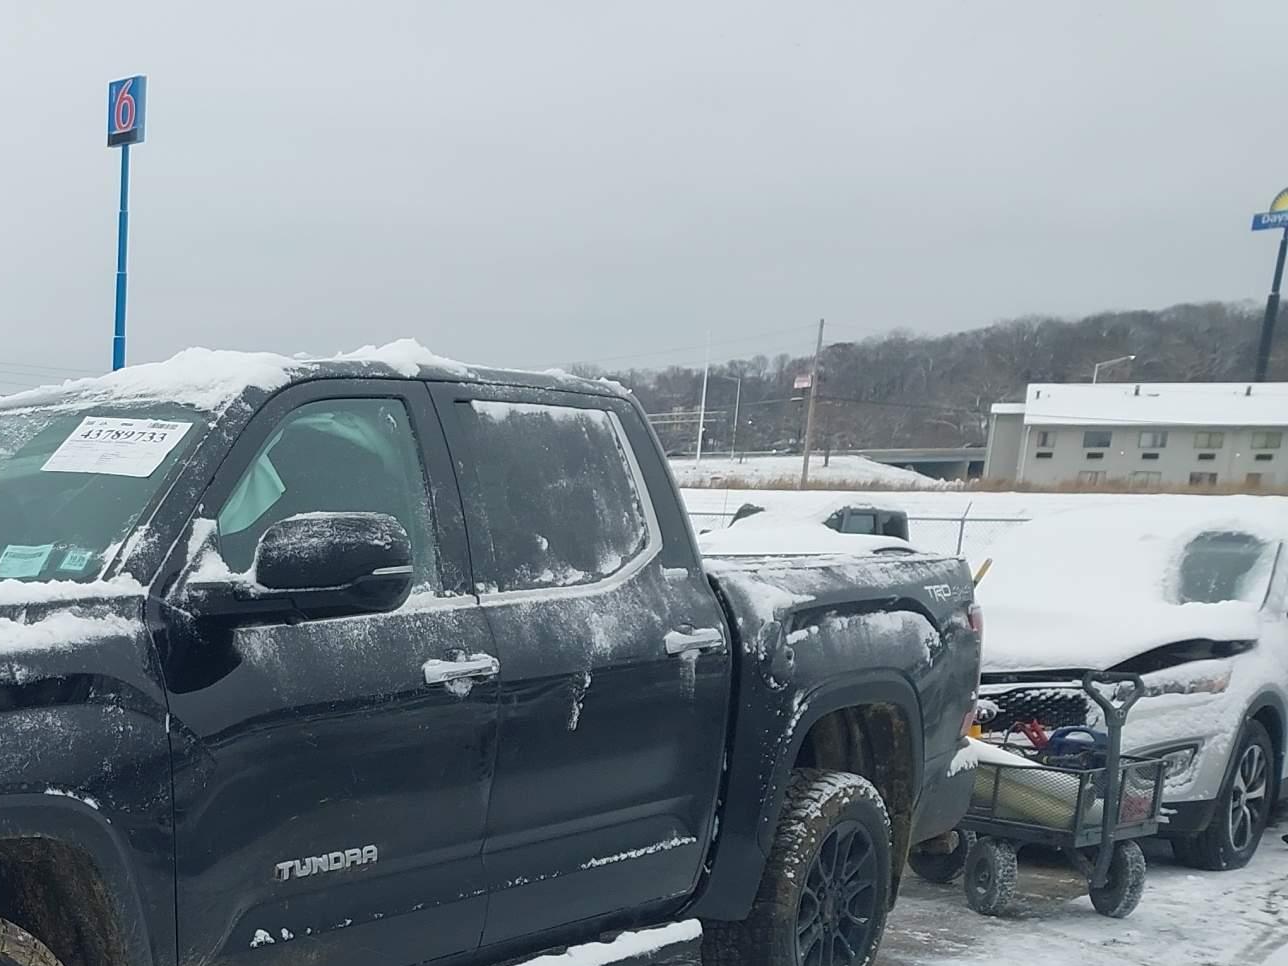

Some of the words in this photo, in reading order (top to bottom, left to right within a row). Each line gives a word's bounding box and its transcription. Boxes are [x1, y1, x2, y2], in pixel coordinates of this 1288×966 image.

[115, 79, 136, 131] 6
[80, 428, 168, 443] 43789733
[924, 584, 951, 602] TRD
[276, 845, 378, 881] TUNDRA
